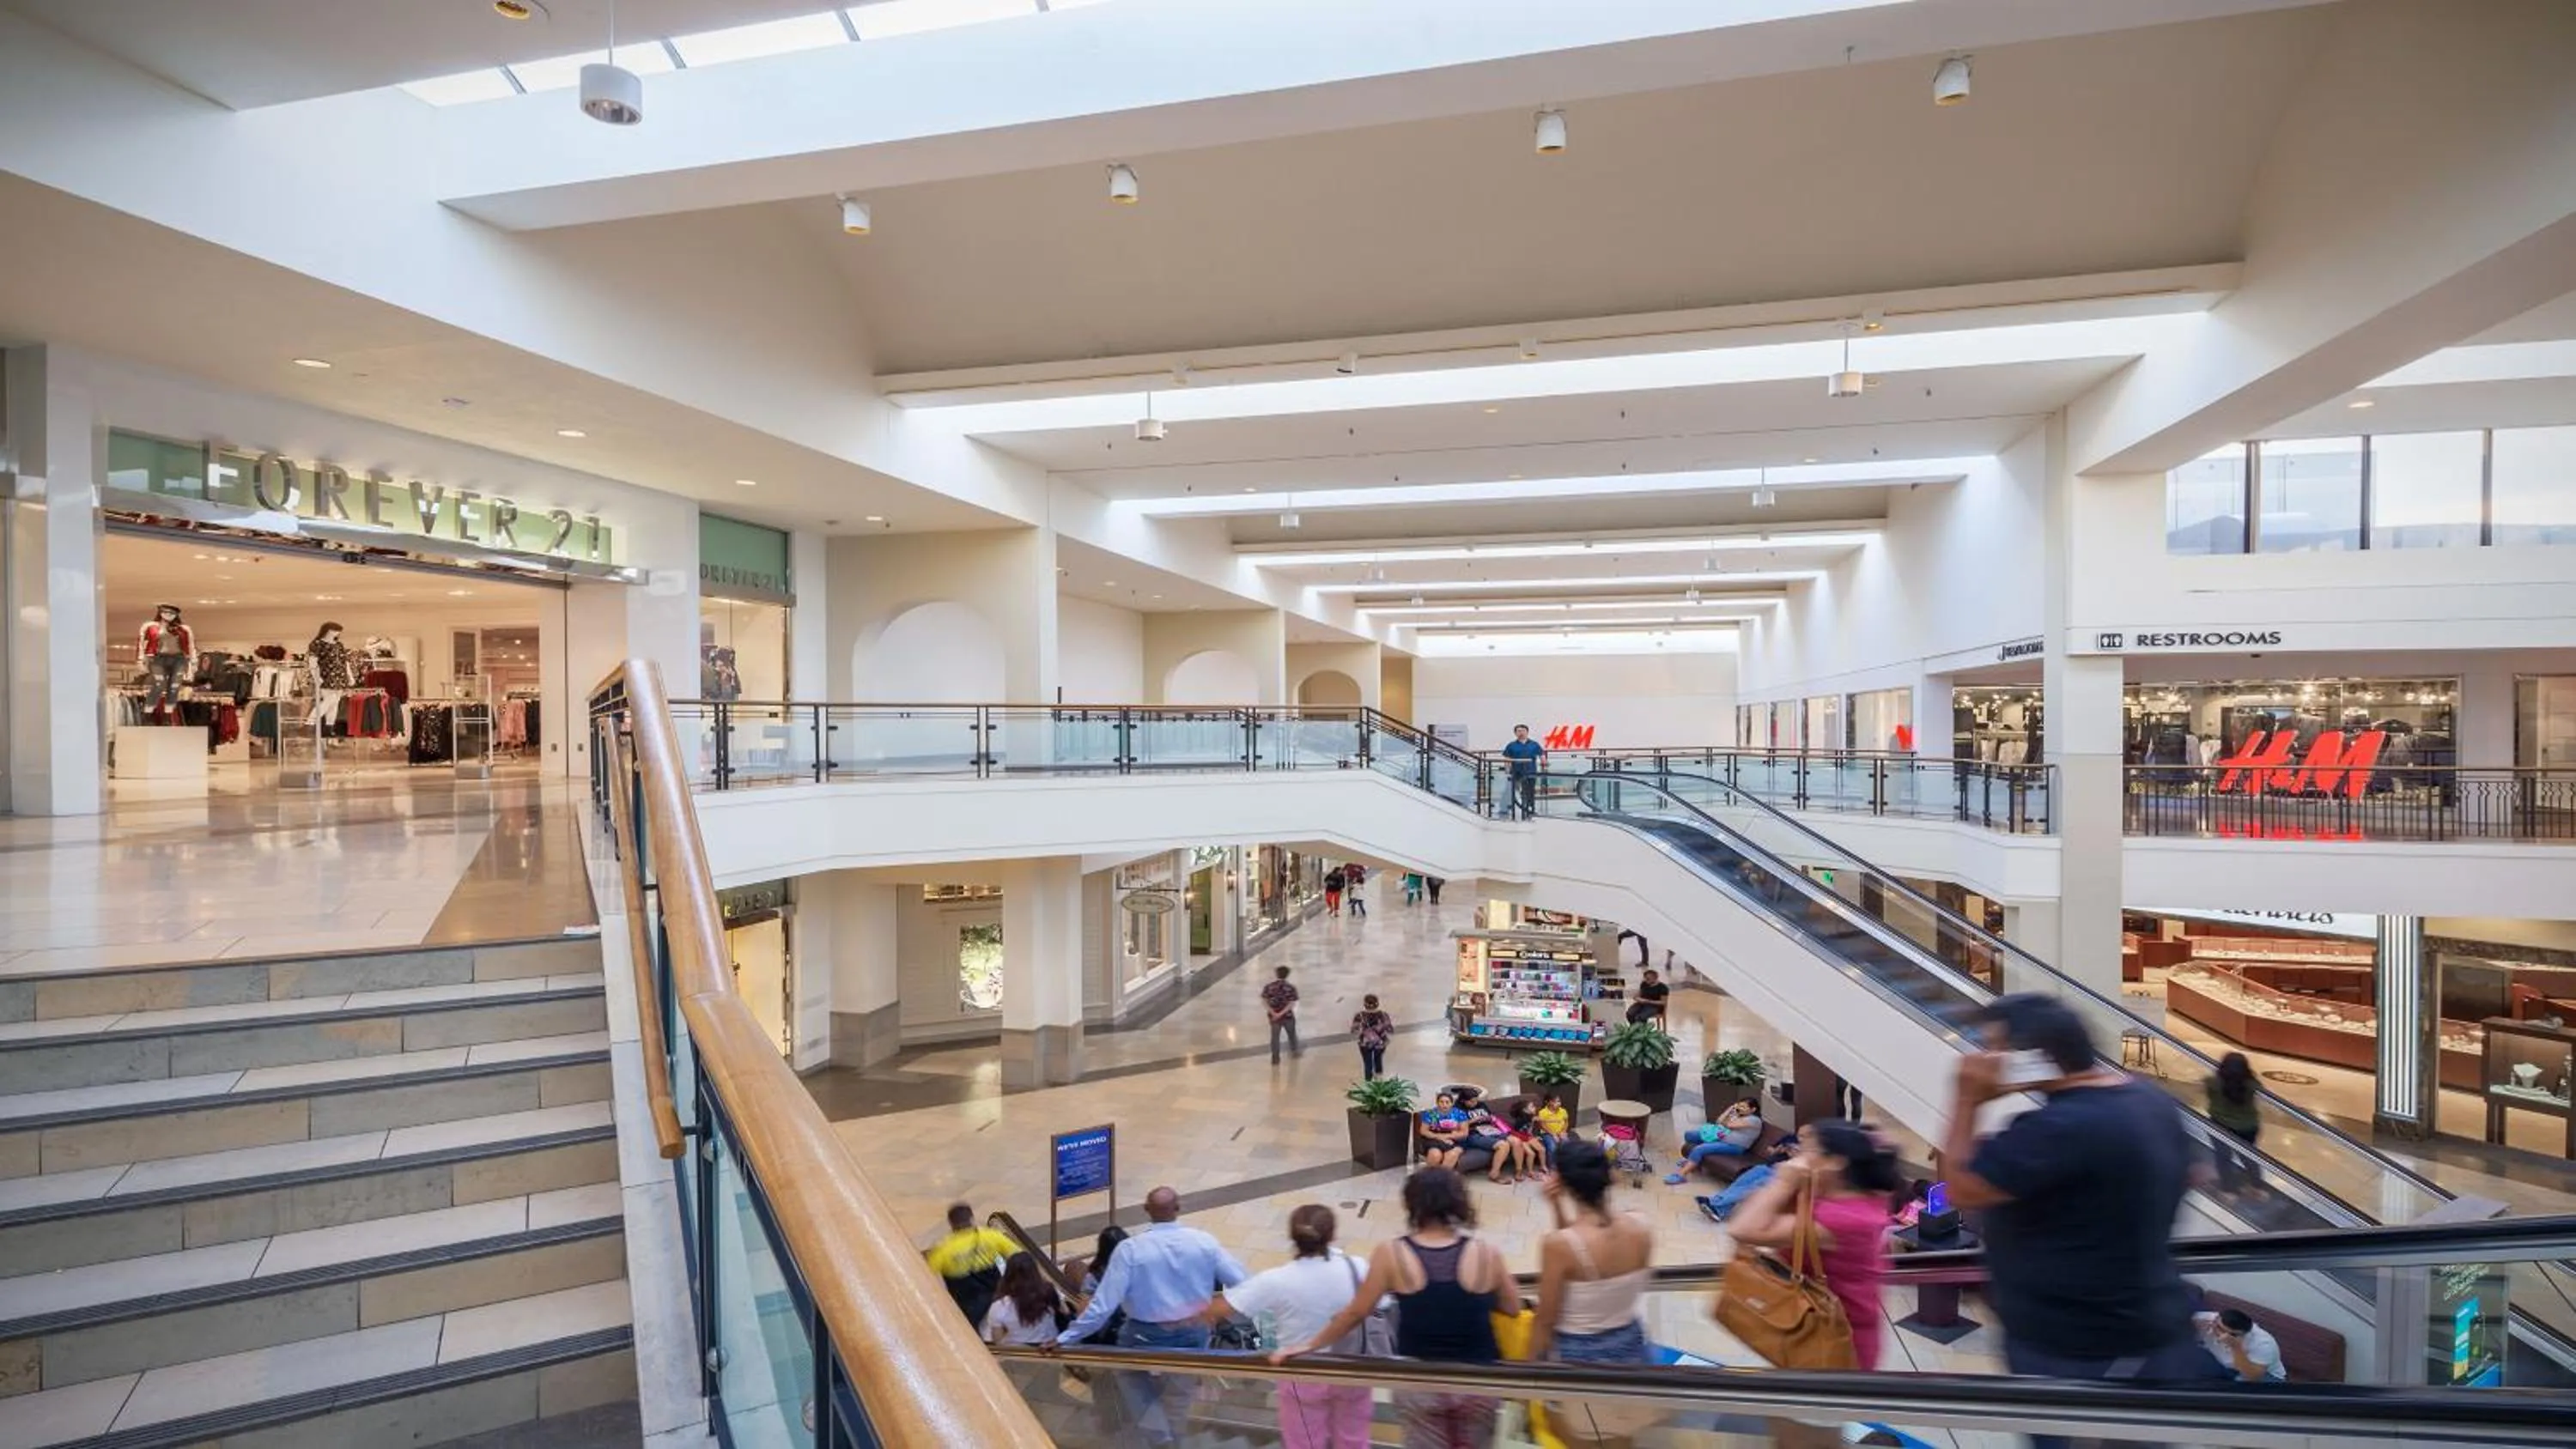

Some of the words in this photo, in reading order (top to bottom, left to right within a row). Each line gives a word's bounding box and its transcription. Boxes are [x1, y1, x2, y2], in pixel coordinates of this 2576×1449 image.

[201, 439, 518, 549] FOREVER
[546, 509, 600, 559] 21
[2136, 631, 2281, 646] RESTROOMS
[1544, 724, 1595, 749] H&M
[2217, 728, 2386, 801] H&M
